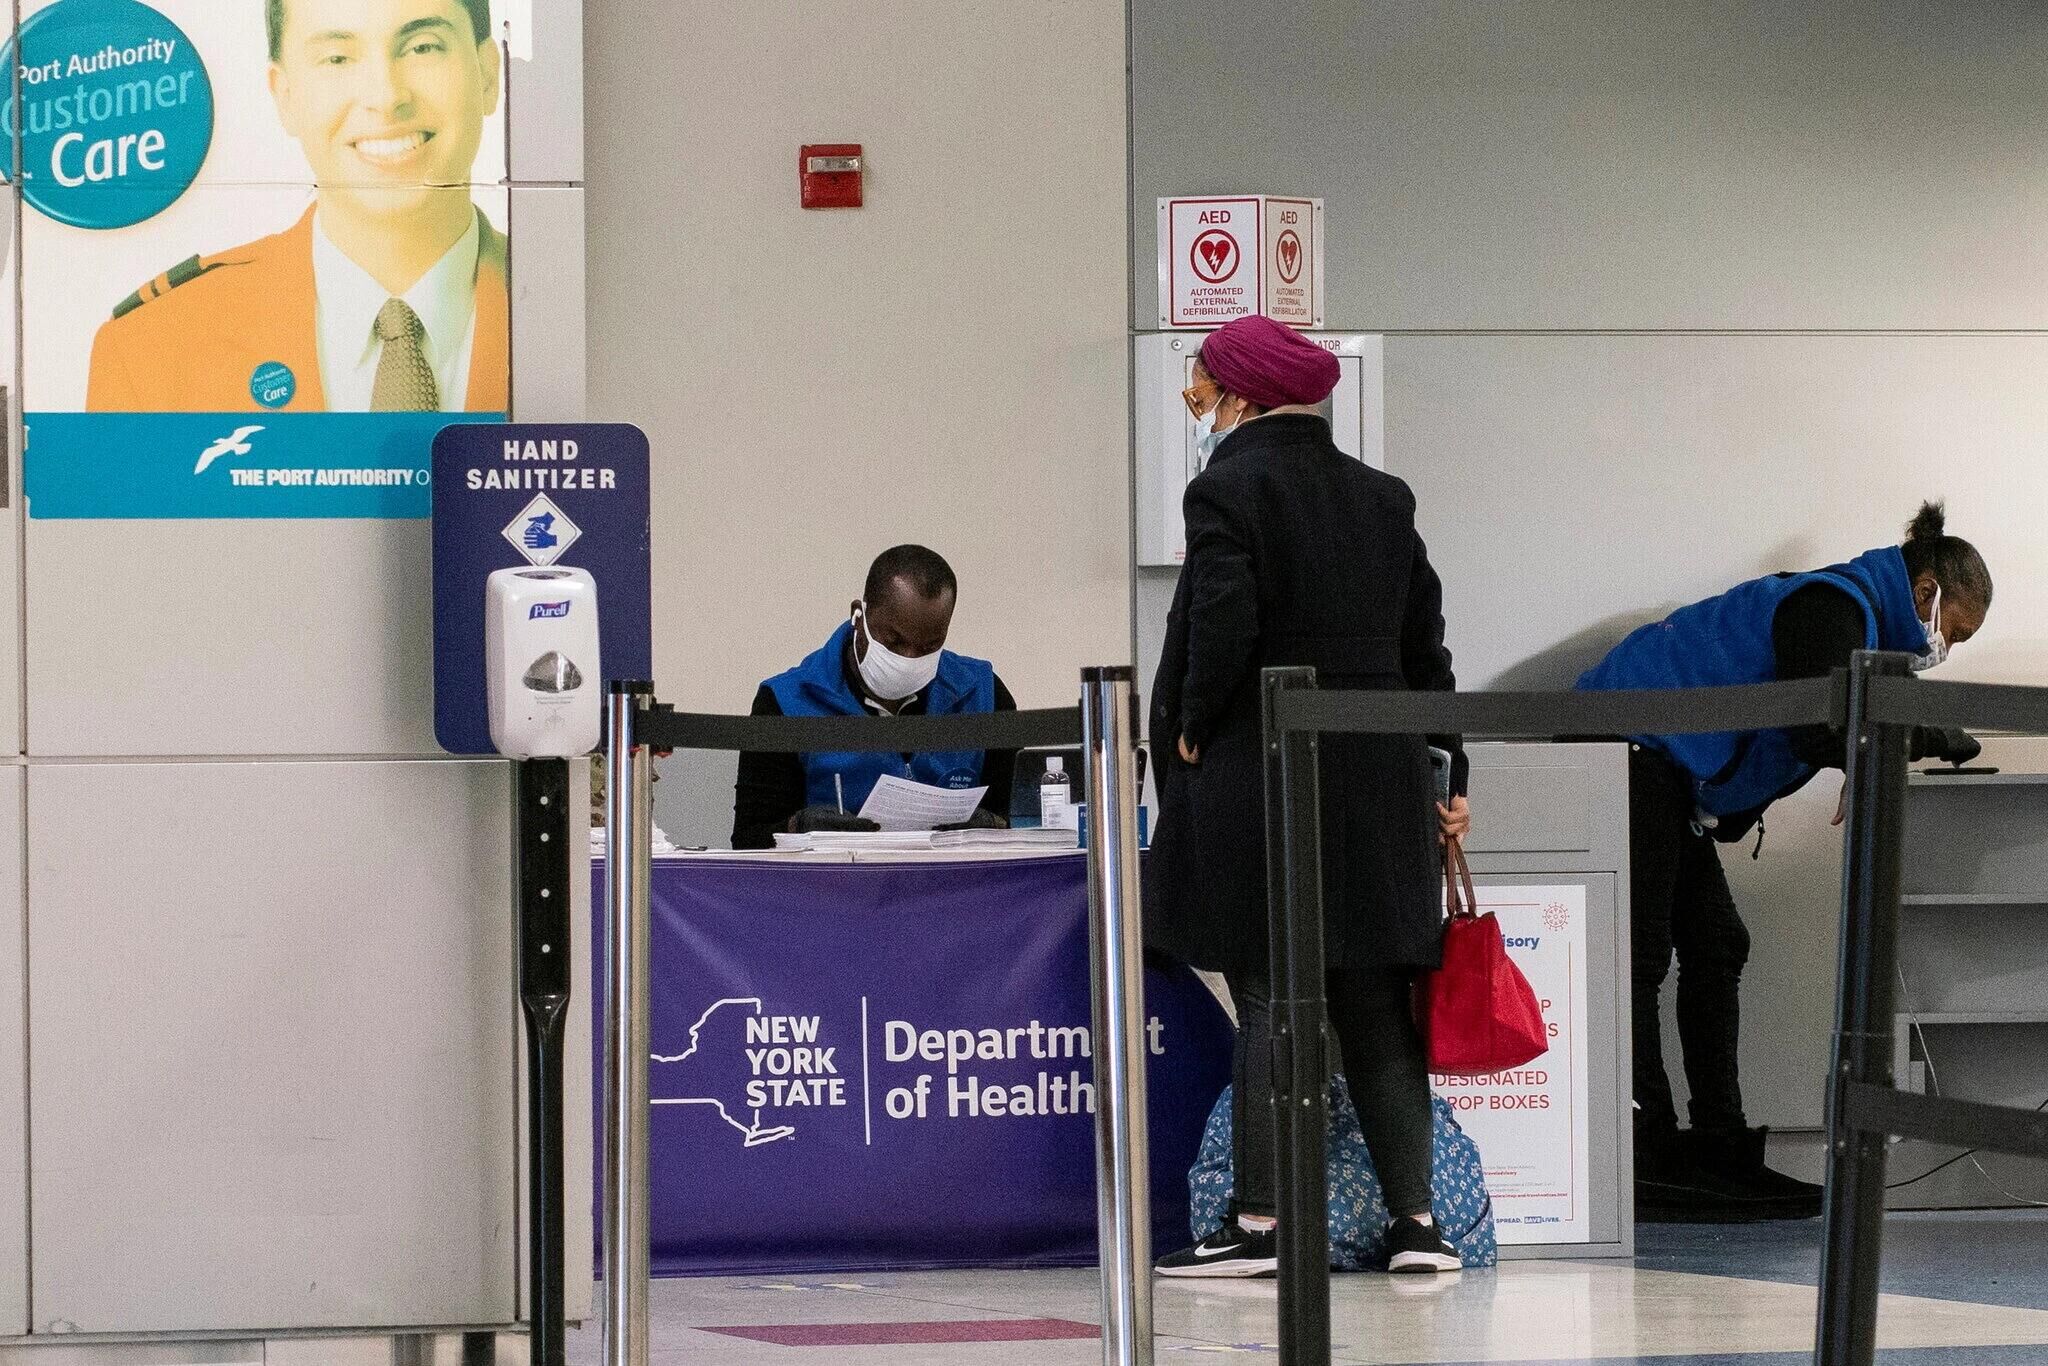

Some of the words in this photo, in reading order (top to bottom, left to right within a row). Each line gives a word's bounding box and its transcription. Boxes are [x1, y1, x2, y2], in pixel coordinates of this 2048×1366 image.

[66, 38, 176, 77] Authority
[1, 70, 194, 137] Customer
[51, 130, 166, 188] Care
[1198, 210, 1231, 224] AED
[1280, 211, 1298, 224] AED
[1190, 287, 1244, 297] AUTOMATED
[1276, 288, 1304, 297] AUTOMATED
[1193, 297, 1238, 306] EXTERNAL
[1277, 297, 1301, 306] EXTERNAL
[1182, 306, 1249, 316] DEFIBRILLATOR
[263, 386, 288, 402] Care
[503, 440, 579, 461] HAND
[230, 469, 263, 486] THE
[266, 469, 314, 486] PORT
[315, 469, 414, 486] AUTHORITY
[416, 469, 430, 486] O
[467, 468, 616, 490] SANITIZER
[1501, 934, 1540, 950] isory
[746, 1016, 820, 1043] NEW
[885, 1016, 1166, 1074] Departmt
[745, 1047, 838, 1075] YORK
[1434, 1070, 1548, 1086] DESIGNATED
[746, 1079, 846, 1107] STATE
[885, 1074, 932, 1119] of
[948, 1071, 1097, 1118] Health
[1446, 1096, 1484, 1110] ROP
[1490, 1095, 1550, 1109] BOXES
